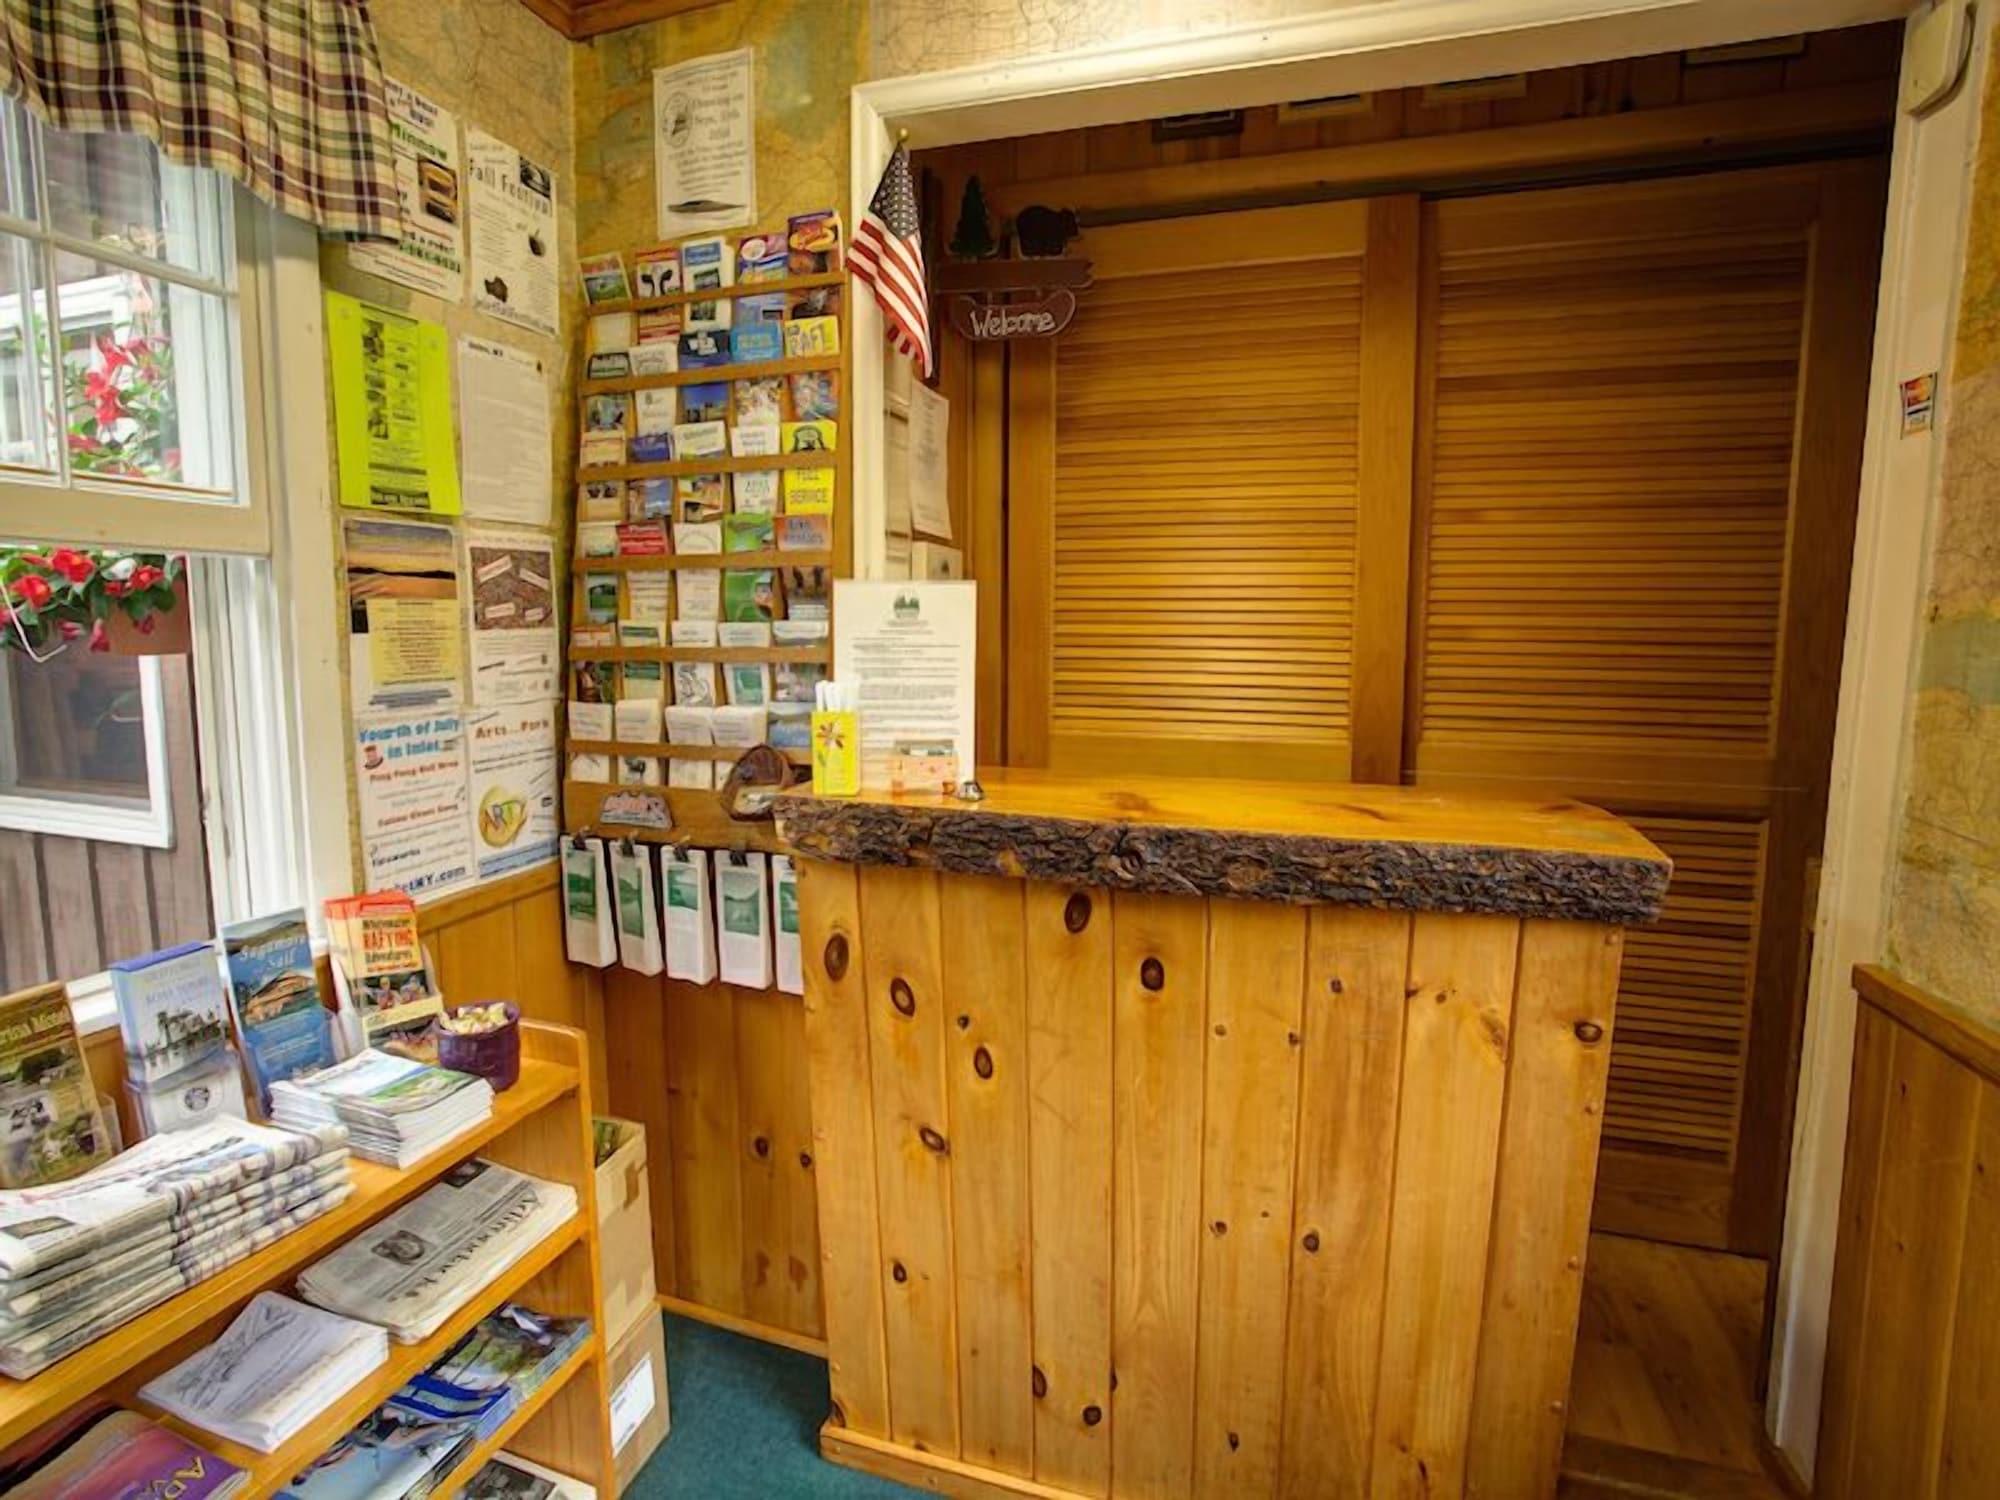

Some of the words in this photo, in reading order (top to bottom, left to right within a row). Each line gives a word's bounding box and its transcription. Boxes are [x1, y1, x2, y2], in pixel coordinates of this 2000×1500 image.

[468, 156, 496, 191] Fall
[969, 307, 1056, 338] Welcome
[359, 724, 411, 743] Fourth
[415, 721, 431, 735] of
[434, 718, 459, 733] July
[475, 725, 508, 740] Arts
[520, 719, 550, 732] Park
[406, 740, 440, 757] Inlet
[363, 928, 414, 951] RAFTING
